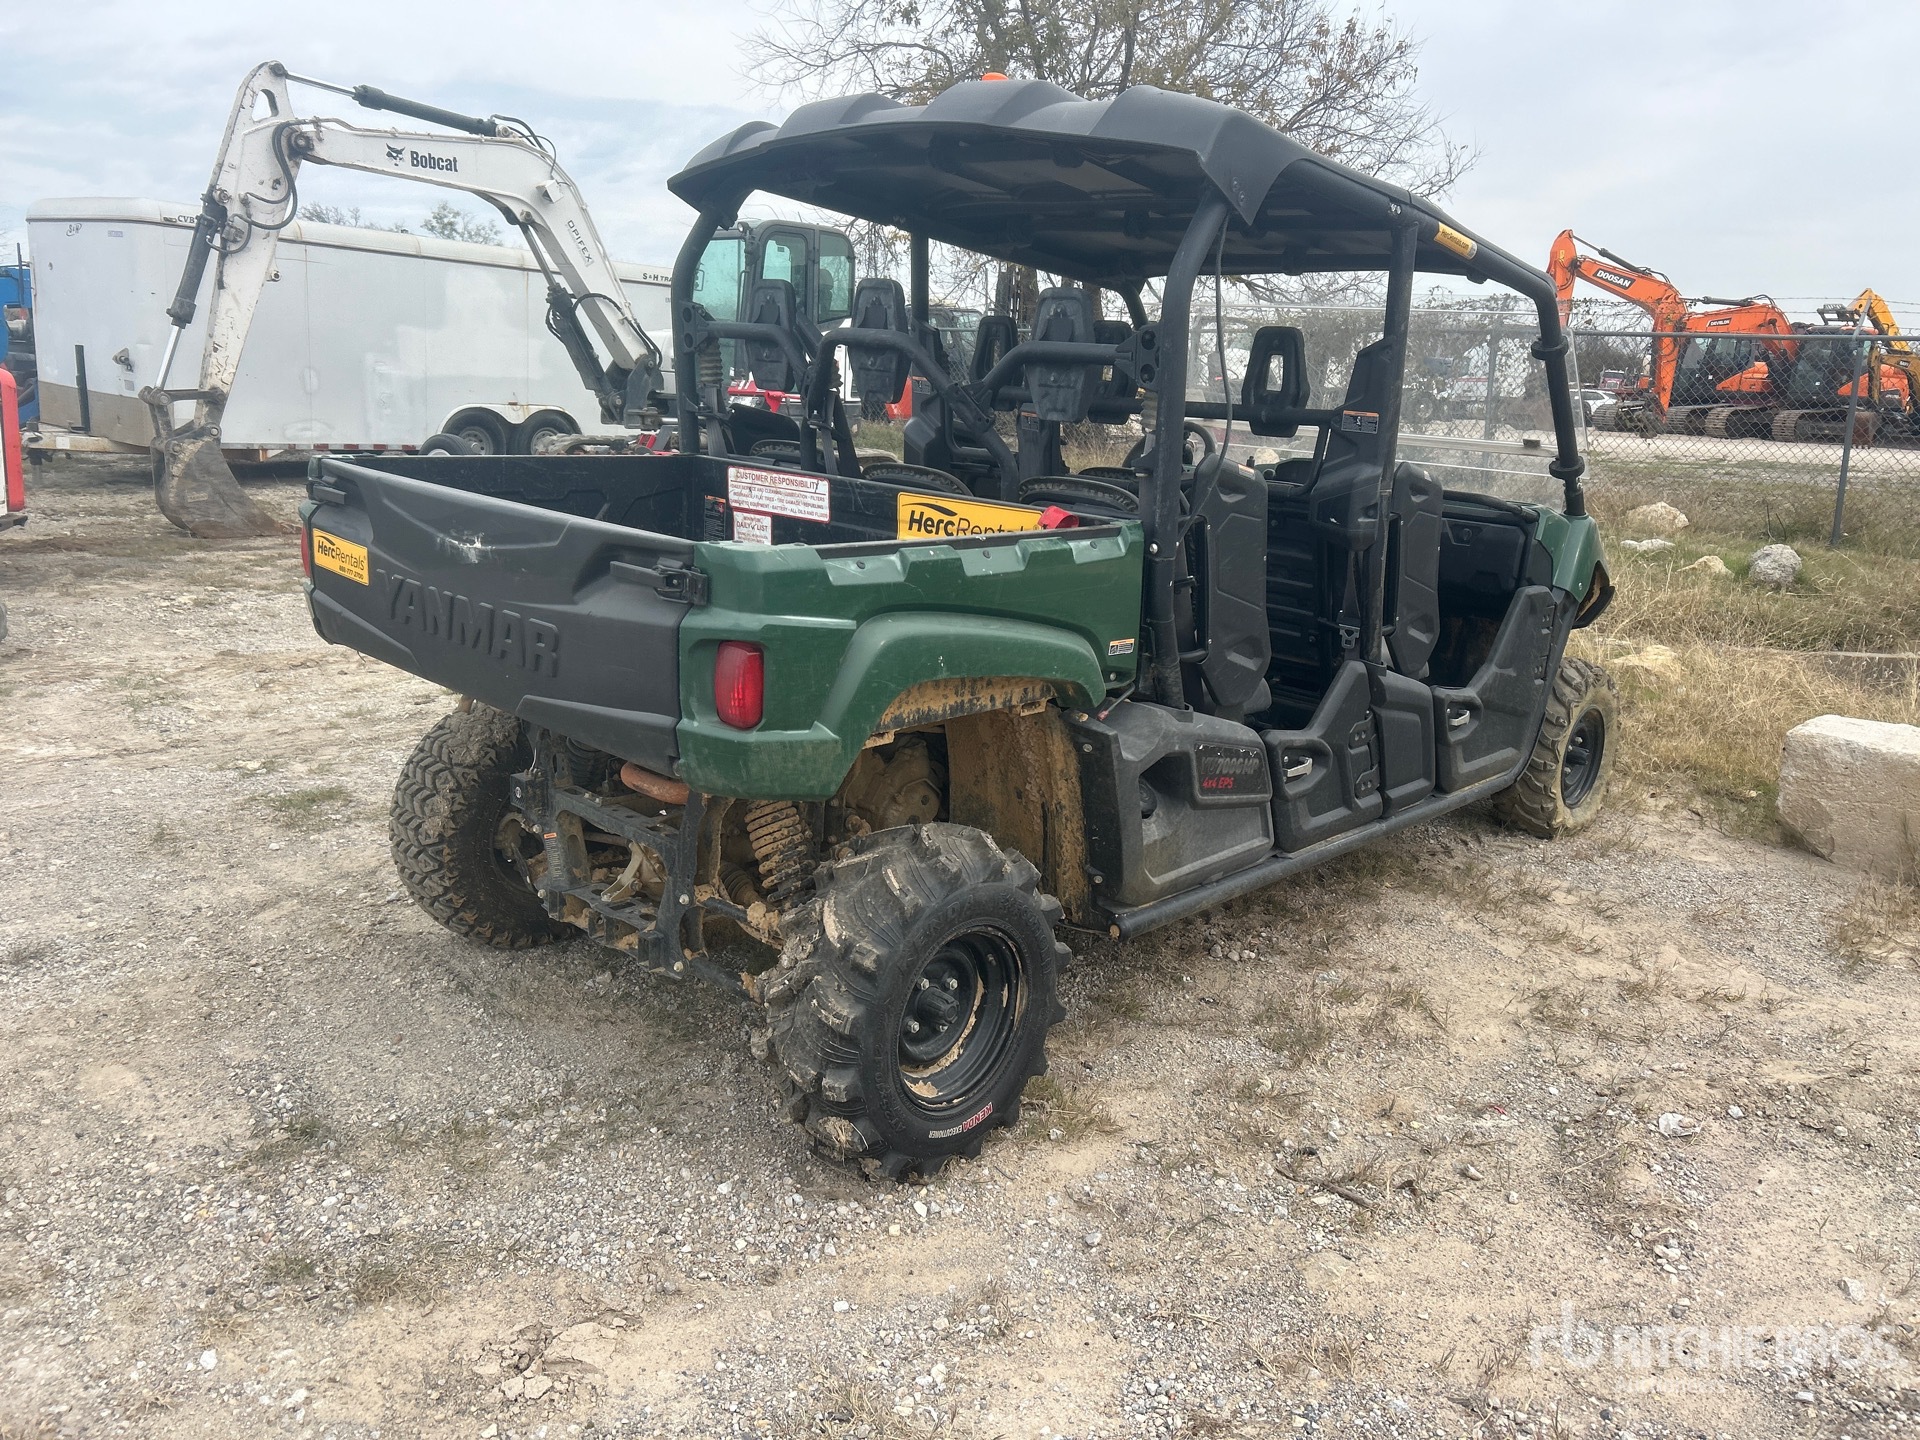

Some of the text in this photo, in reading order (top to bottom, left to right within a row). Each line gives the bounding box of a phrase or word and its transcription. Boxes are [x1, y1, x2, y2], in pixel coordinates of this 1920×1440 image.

[410, 150, 458, 172] Bobcat
[567, 220, 592, 262] OPIFEX
[1596, 269, 1631, 288] DOOSAN
[735, 471, 820, 490] CUSTOMER RESPONSIBILITY
[736, 520, 768, 532] DAILY LIST
[317, 539, 365, 571] HercRentals
[376, 568, 560, 679] YANMAR
[1218, 777, 1234, 789] EPS
[928, 1101, 993, 1139] KENDA EXECUTIONER
